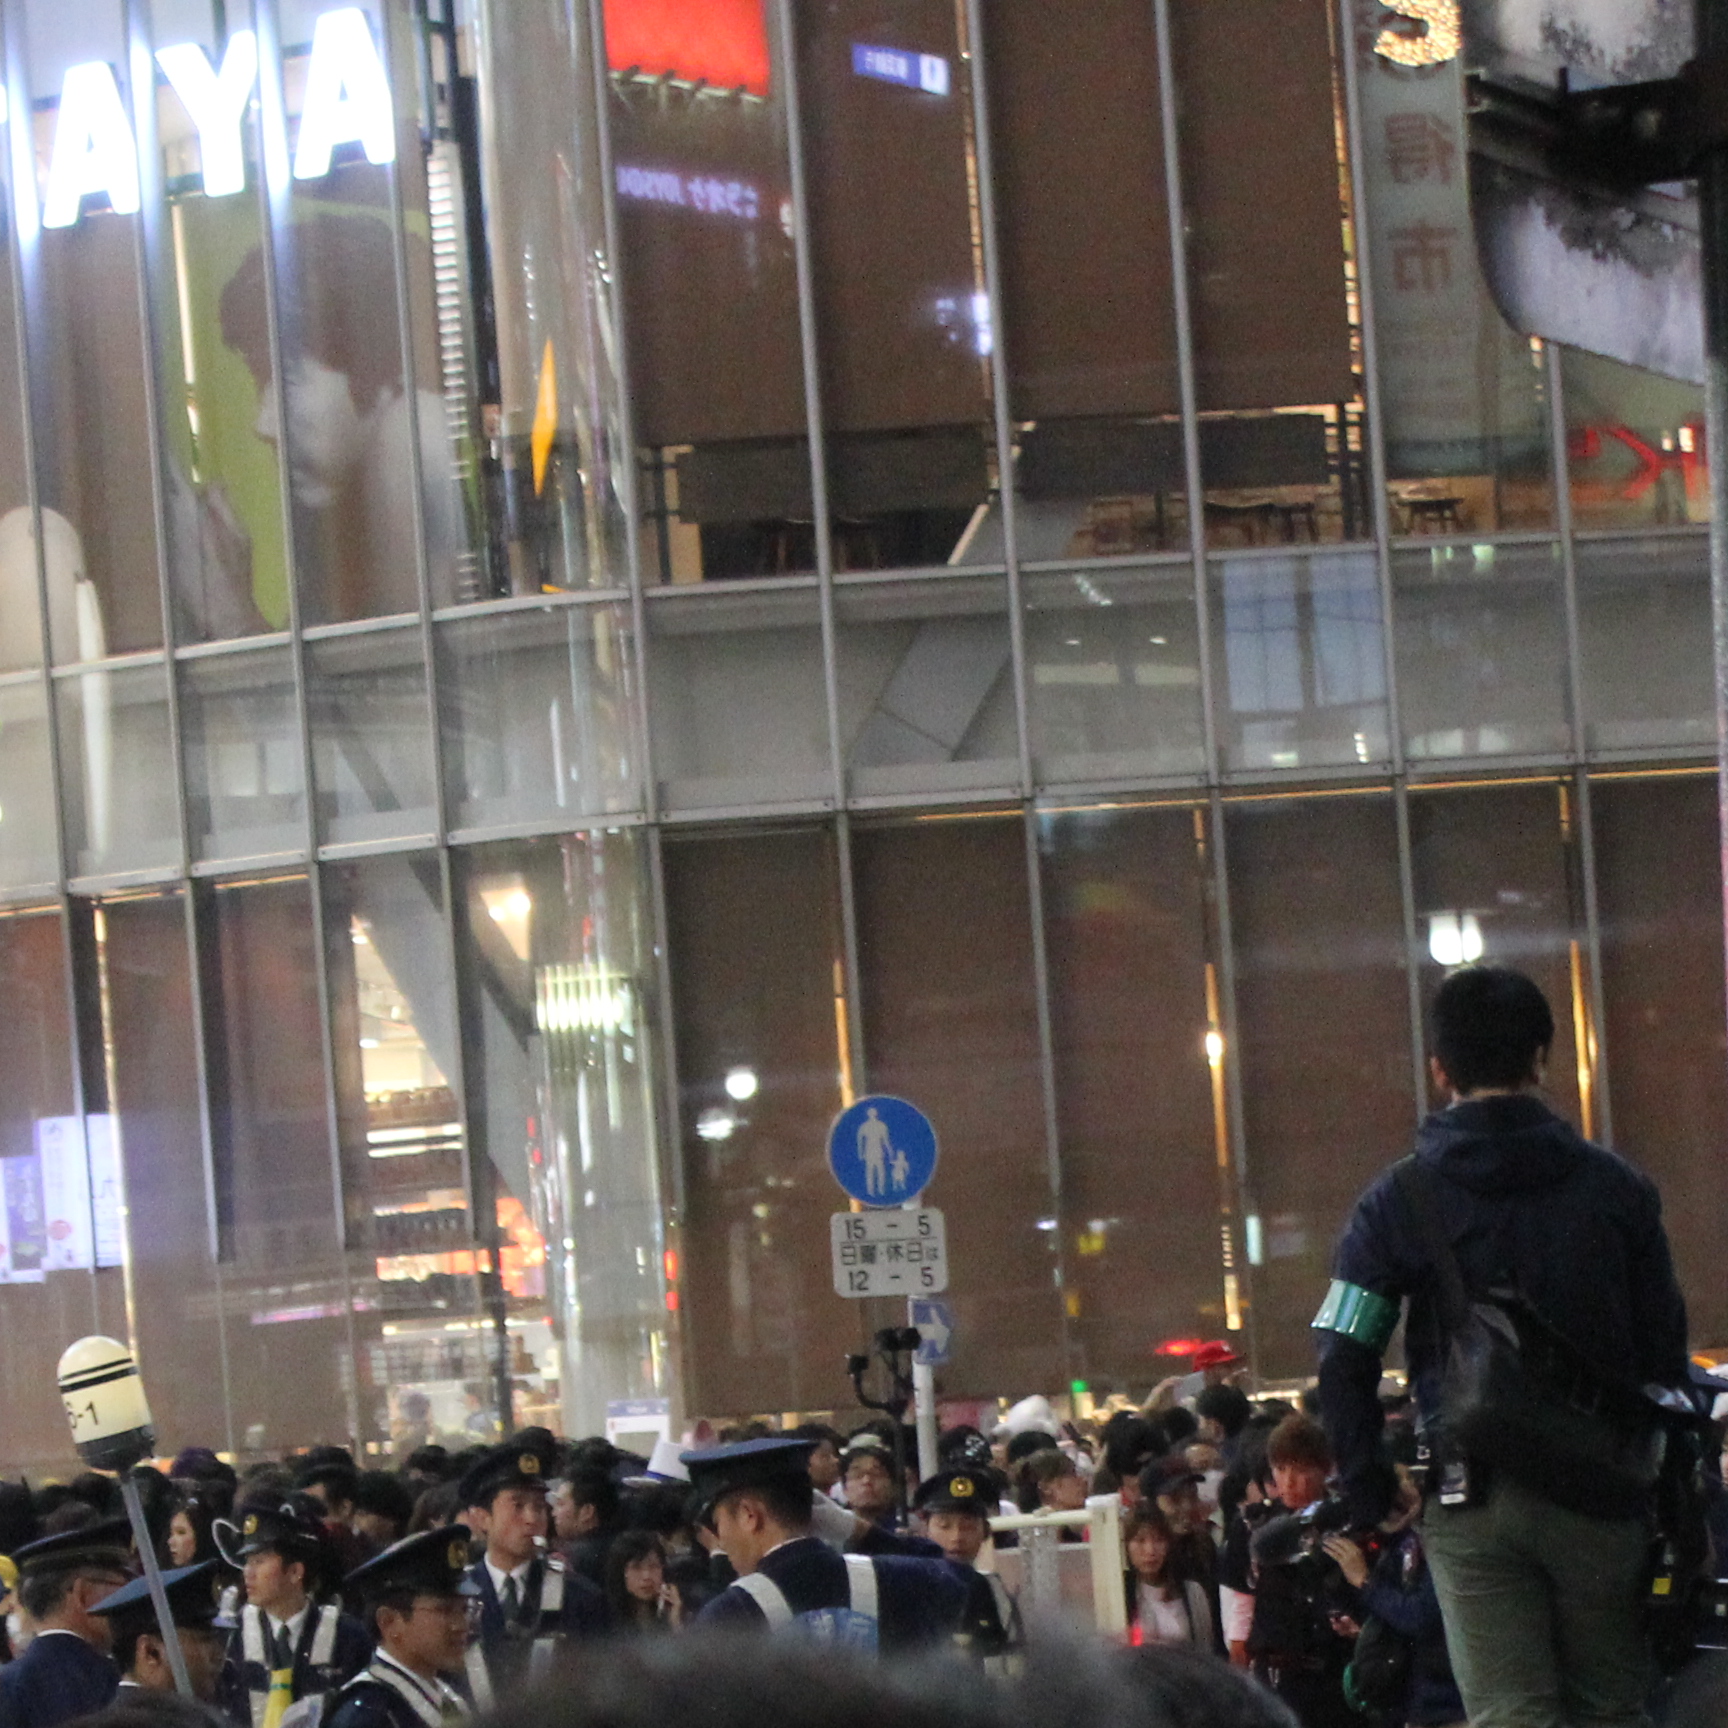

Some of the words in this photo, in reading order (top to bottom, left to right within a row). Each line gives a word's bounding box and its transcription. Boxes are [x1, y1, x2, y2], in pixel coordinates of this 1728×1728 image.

[845, 1218, 867, 1239] 15
[918, 1214, 931, 1236] 5
[849, 1270, 869, 1292] 12
[921, 1266, 934, 1287] 5
